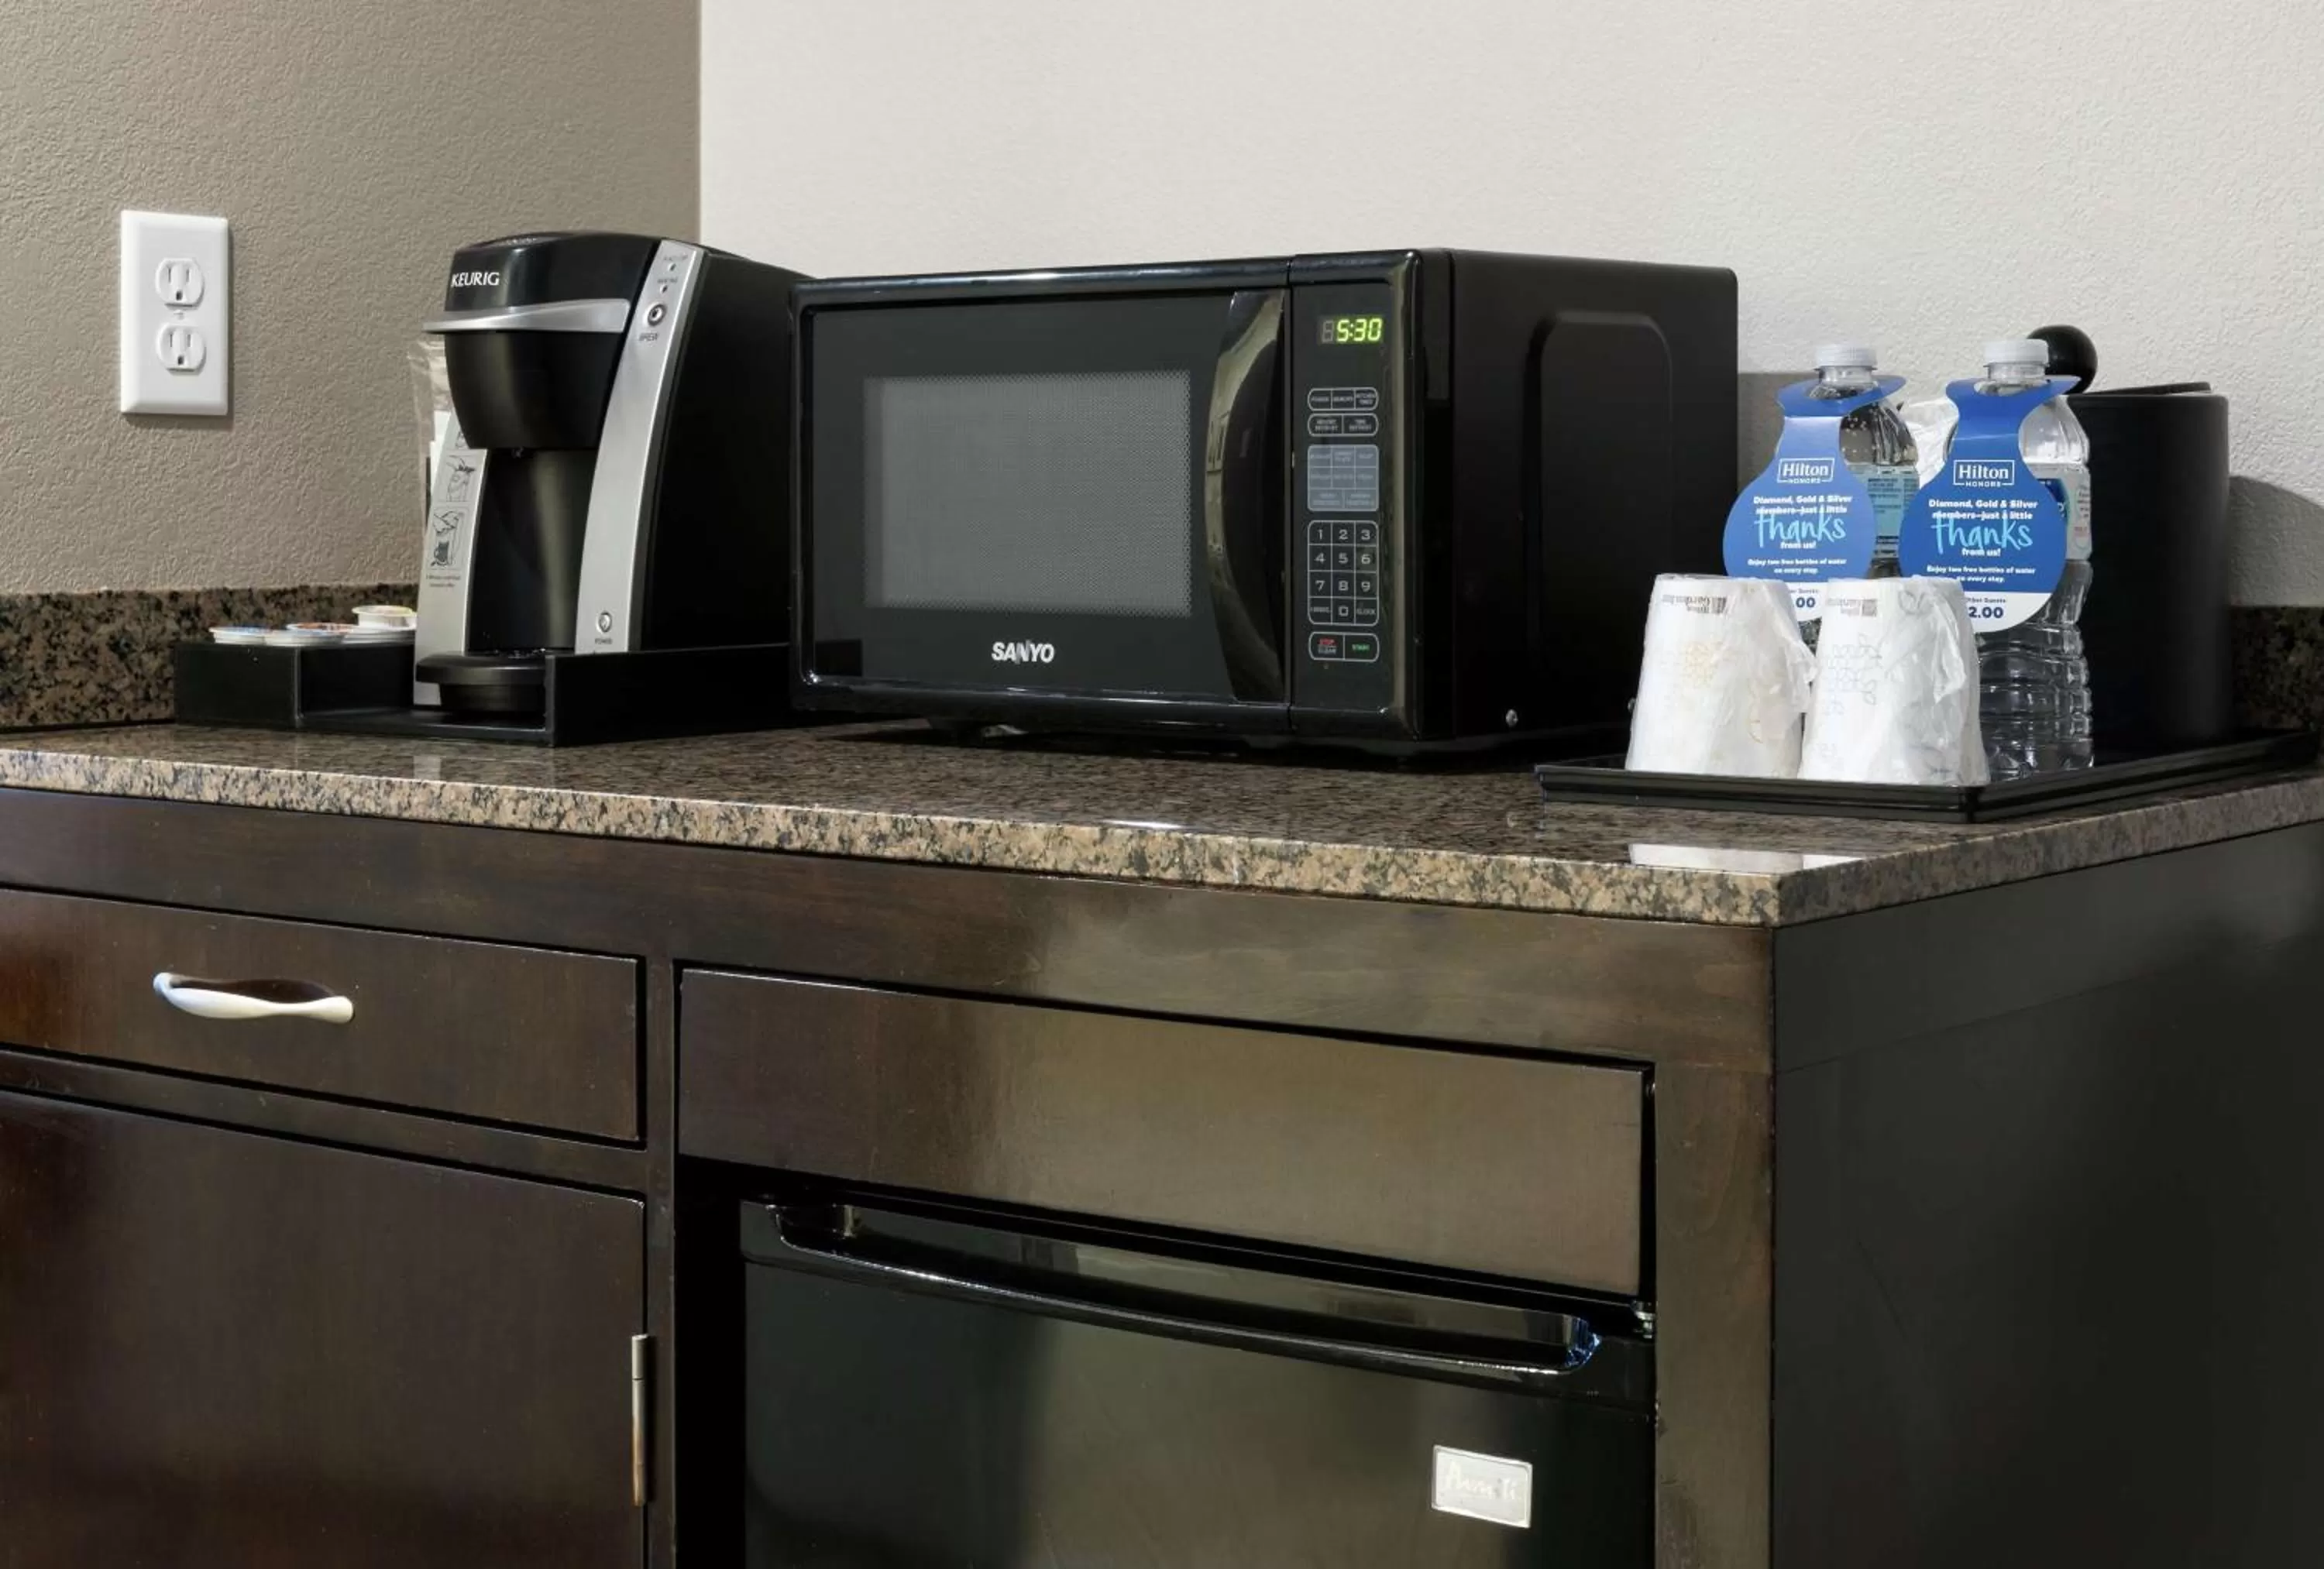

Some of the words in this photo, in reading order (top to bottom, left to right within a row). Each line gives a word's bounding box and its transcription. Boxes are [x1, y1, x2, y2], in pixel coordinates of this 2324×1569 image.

[451, 272, 500, 288] KEURIG
[1337, 318, 1383, 342] 5:30
[1783, 462, 1829, 476] Hilton
[1958, 465, 2009, 479] Hilton
[1754, 496, 1793, 504] Diamond,
[1827, 495, 1853, 503] Silver
[1929, 499, 1973, 508] Diamond,
[1975, 500, 1998, 508] Gold
[2000, 500, 2007, 508] &
[2010, 499, 2038, 508] Silver
[1827, 505, 1848, 513] little
[2009, 510, 2033, 520] little
[1754, 506, 1846, 548] thanks
[1930, 510, 2033, 554] thanks
[1318, 529, 1323, 540] 1
[1339, 529, 1349, 540] 2
[1361, 529, 1370, 541] 3
[1803, 541, 1817, 549] us!
[1961, 548, 1985, 556] from
[1987, 548, 2001, 557] us!
[1315, 553, 1326, 564] 4
[1338, 553, 1348, 564] 5
[1361, 554, 1371, 565] 6
[1927, 565, 1947, 574] Enjoy
[1315, 580, 1325, 592] 7
[1338, 580, 1349, 591] 8
[1361, 581, 1370, 592] 9
[1338, 606, 1349, 616] 0
[992, 640, 1055, 664] SANYO
